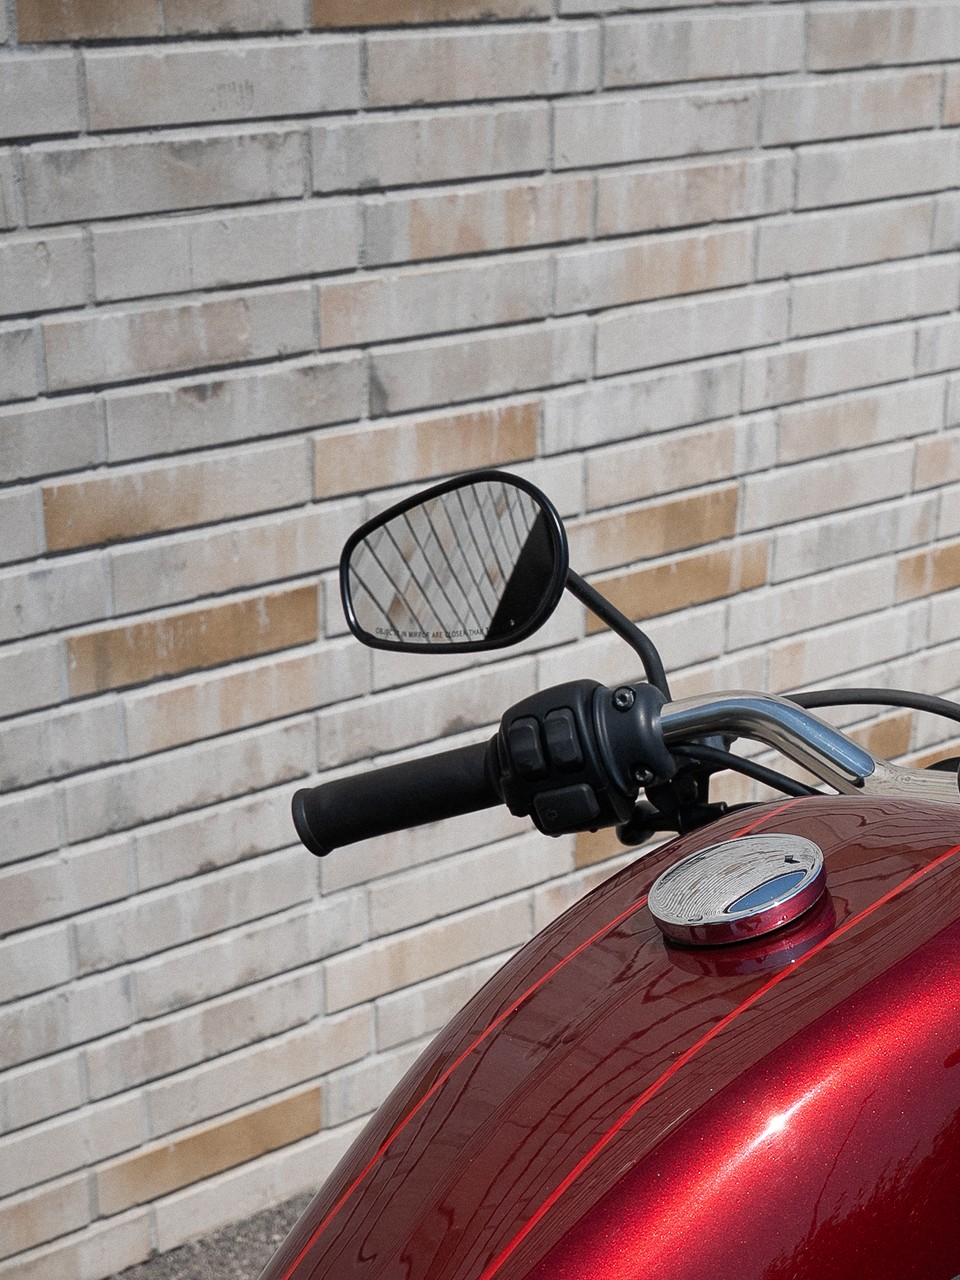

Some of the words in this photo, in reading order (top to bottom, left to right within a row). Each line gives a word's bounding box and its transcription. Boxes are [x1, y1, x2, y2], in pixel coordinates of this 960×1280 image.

[375, 627, 400, 637] OBJECTS
[408, 631, 430, 639] MIRROR
[432, 631, 443, 639] ARE
[445, 630, 467, 639] CLOSER
[468, 627, 484, 636] THAN
